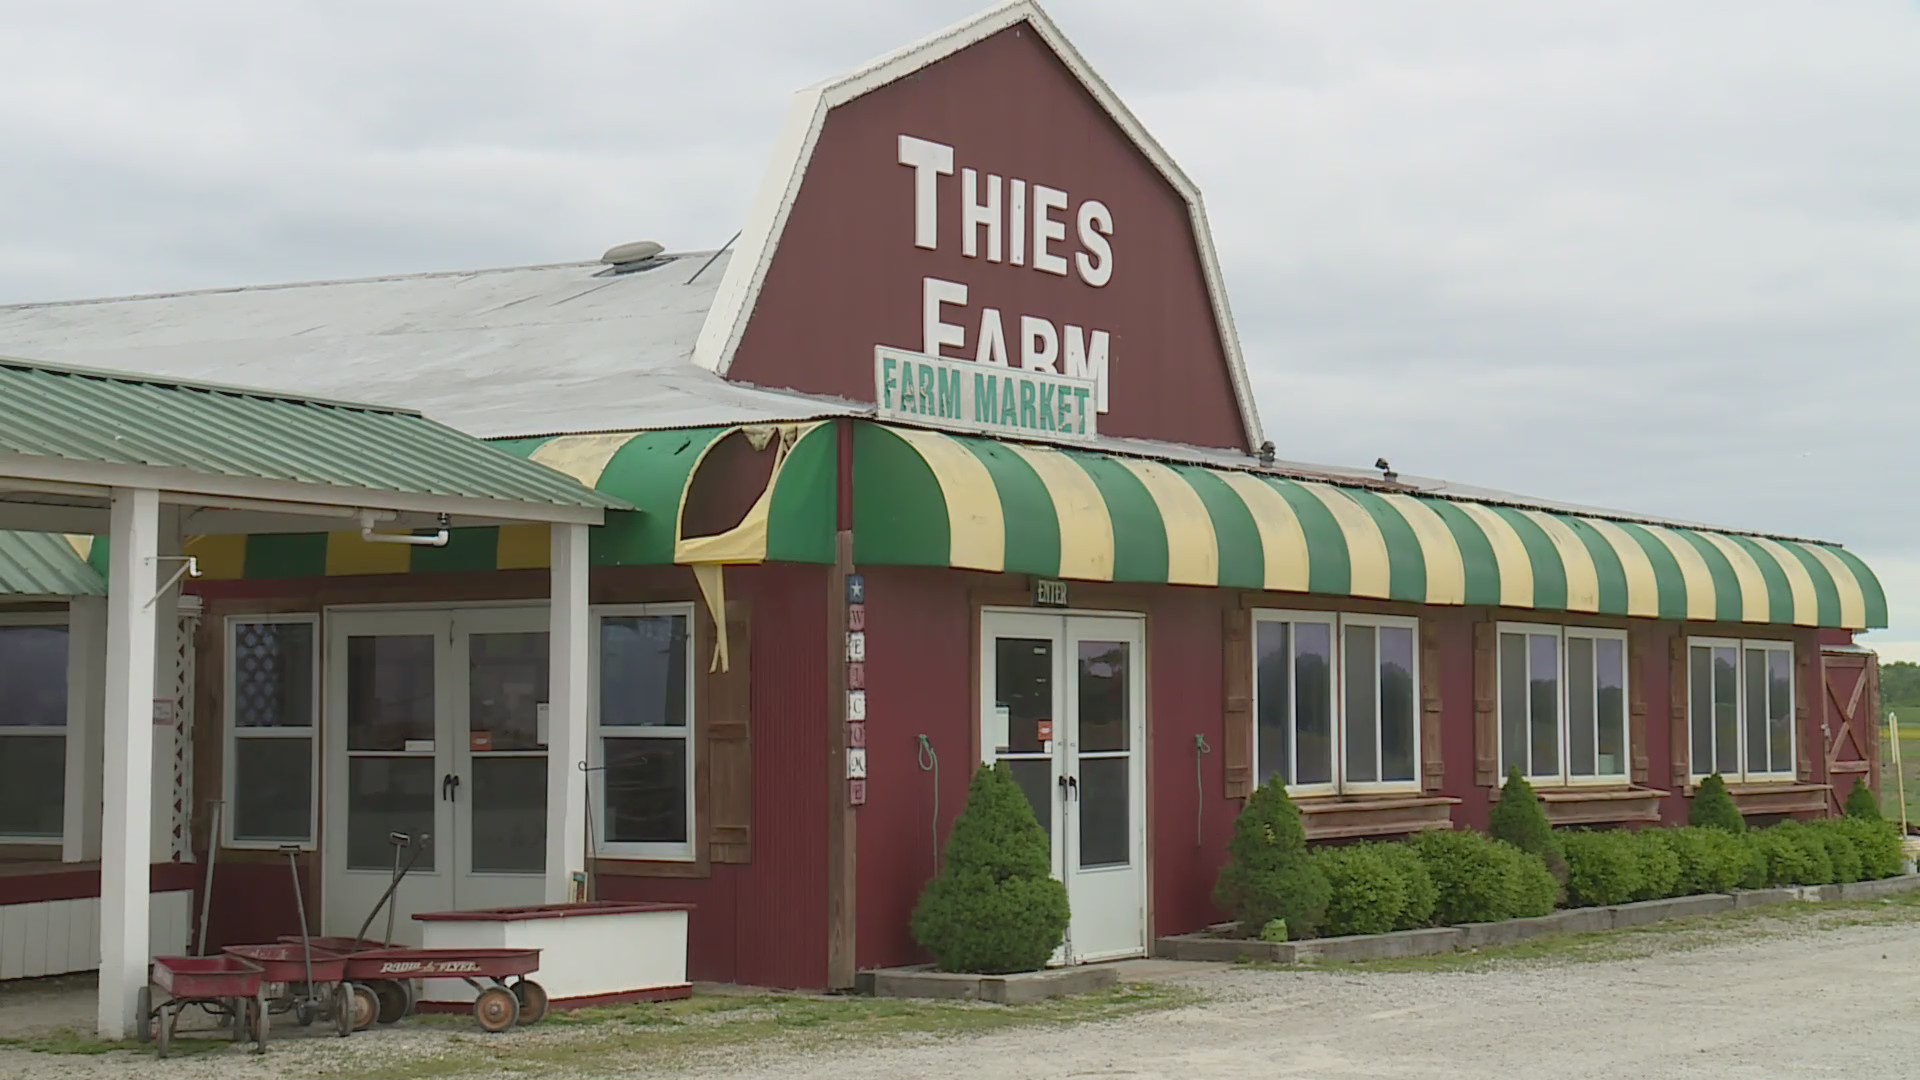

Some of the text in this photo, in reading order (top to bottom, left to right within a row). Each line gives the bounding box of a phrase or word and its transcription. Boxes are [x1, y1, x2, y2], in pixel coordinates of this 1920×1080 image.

[897, 134, 1114, 287] THIES
[883, 357, 1089, 435] FARM MARKET
[922, 277, 1110, 414] FARM
[1038, 579, 1067, 605] ENTER
[850, 609, 865, 801] WELCOME
